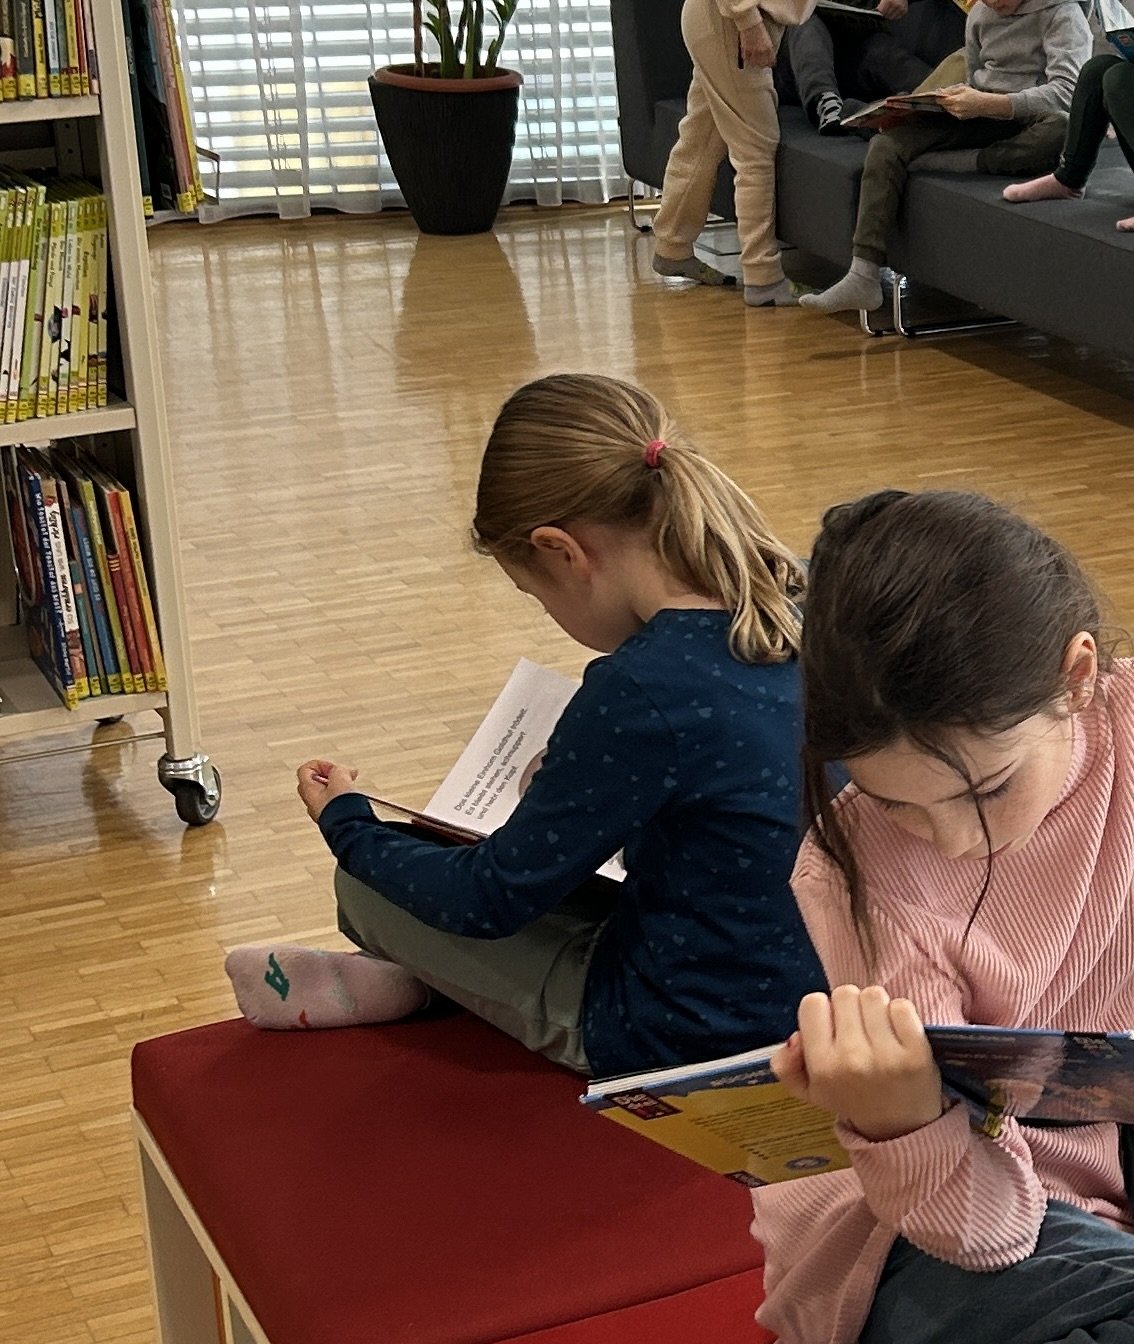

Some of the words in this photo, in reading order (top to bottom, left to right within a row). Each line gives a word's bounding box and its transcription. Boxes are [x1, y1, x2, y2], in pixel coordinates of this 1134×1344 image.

[454, 799, 467, 811] Das
[478, 755, 497, 779] Einhorn
[466, 807, 475, 815] Es
[478, 808, 488, 819] und
